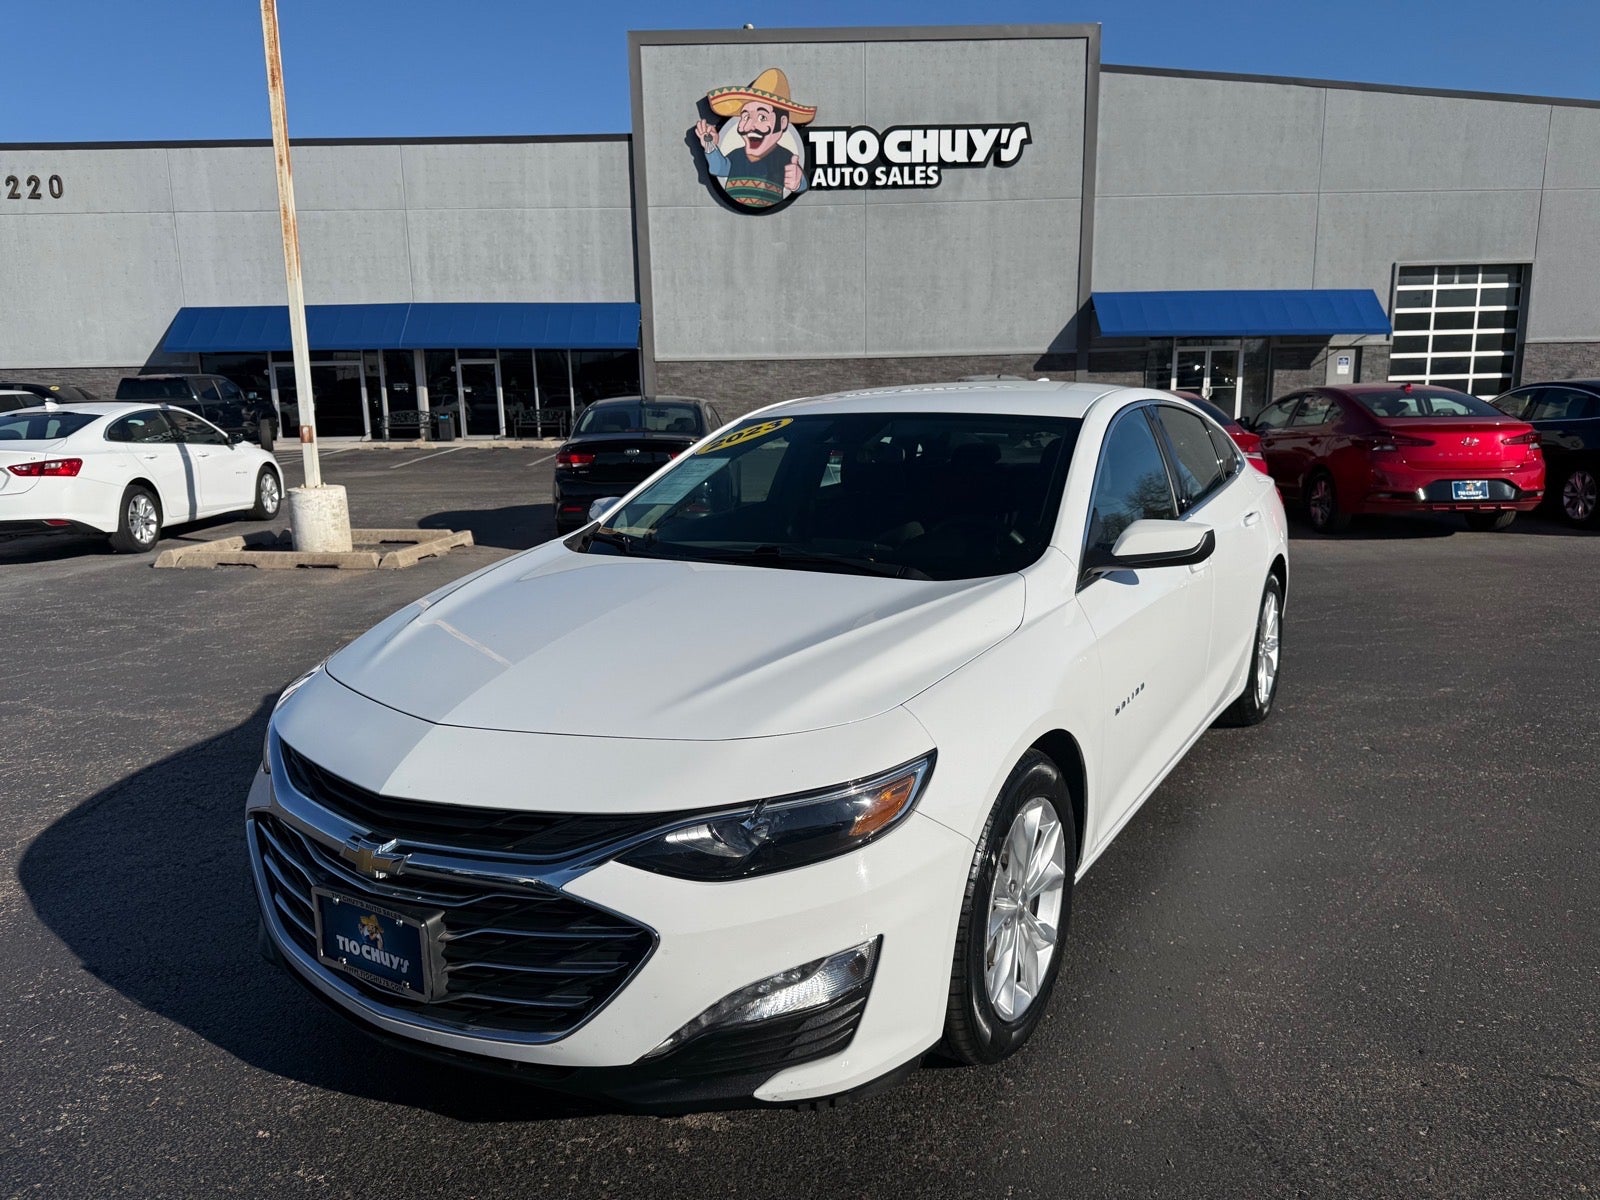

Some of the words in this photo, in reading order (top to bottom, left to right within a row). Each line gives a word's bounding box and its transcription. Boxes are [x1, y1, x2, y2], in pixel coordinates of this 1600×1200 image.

[809, 130, 879, 165] TIO
[884, 126, 1027, 163] CHUY'S
[812, 167, 868, 187] AUTO
[875, 166, 938, 186] SALES
[705, 421, 782, 451] 2023
[336, 935, 360, 955] TIO
[362, 945, 410, 973] CHUY'S
